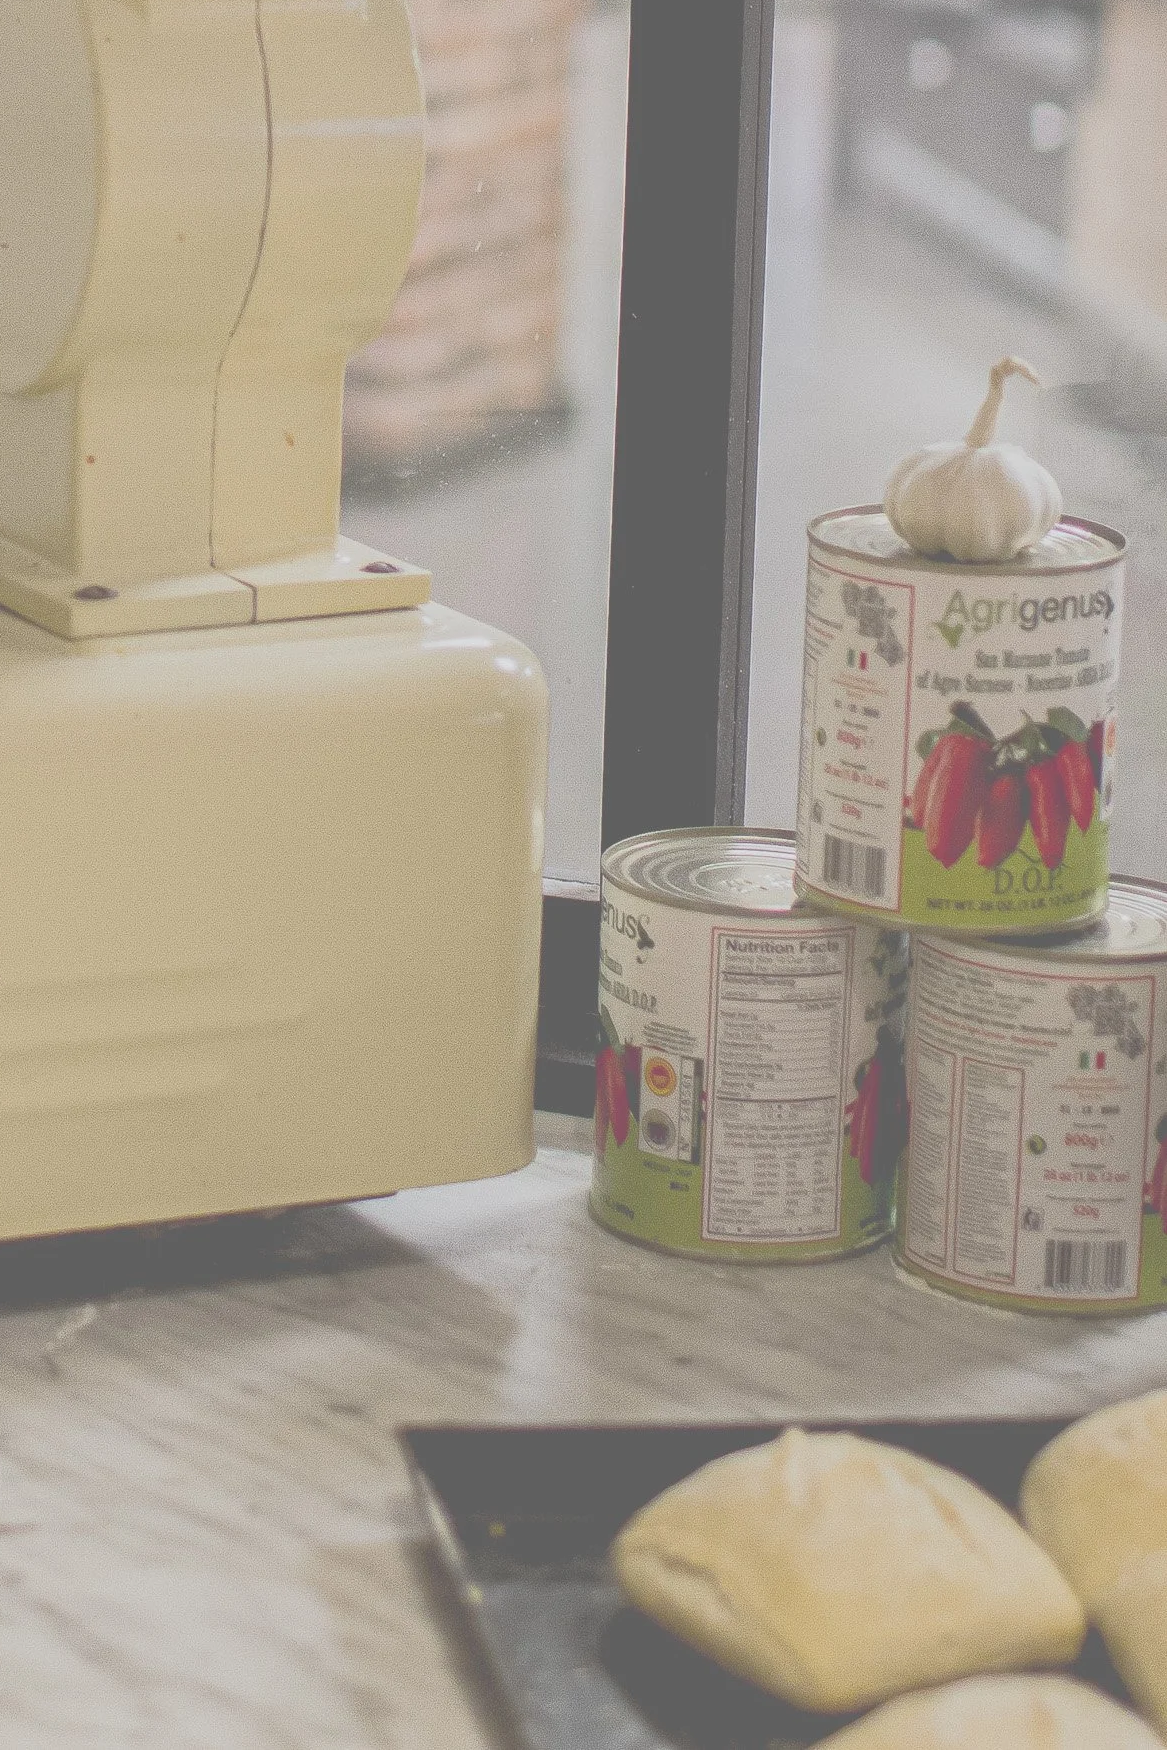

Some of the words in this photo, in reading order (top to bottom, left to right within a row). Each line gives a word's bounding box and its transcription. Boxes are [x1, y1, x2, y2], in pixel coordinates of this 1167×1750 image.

[942, 590, 1106, 633] Agrigenus
[725, 938, 795, 954] Nutrition
[799, 939, 840, 954] Facts
[1064, 1132, 1099, 1151] 800g
